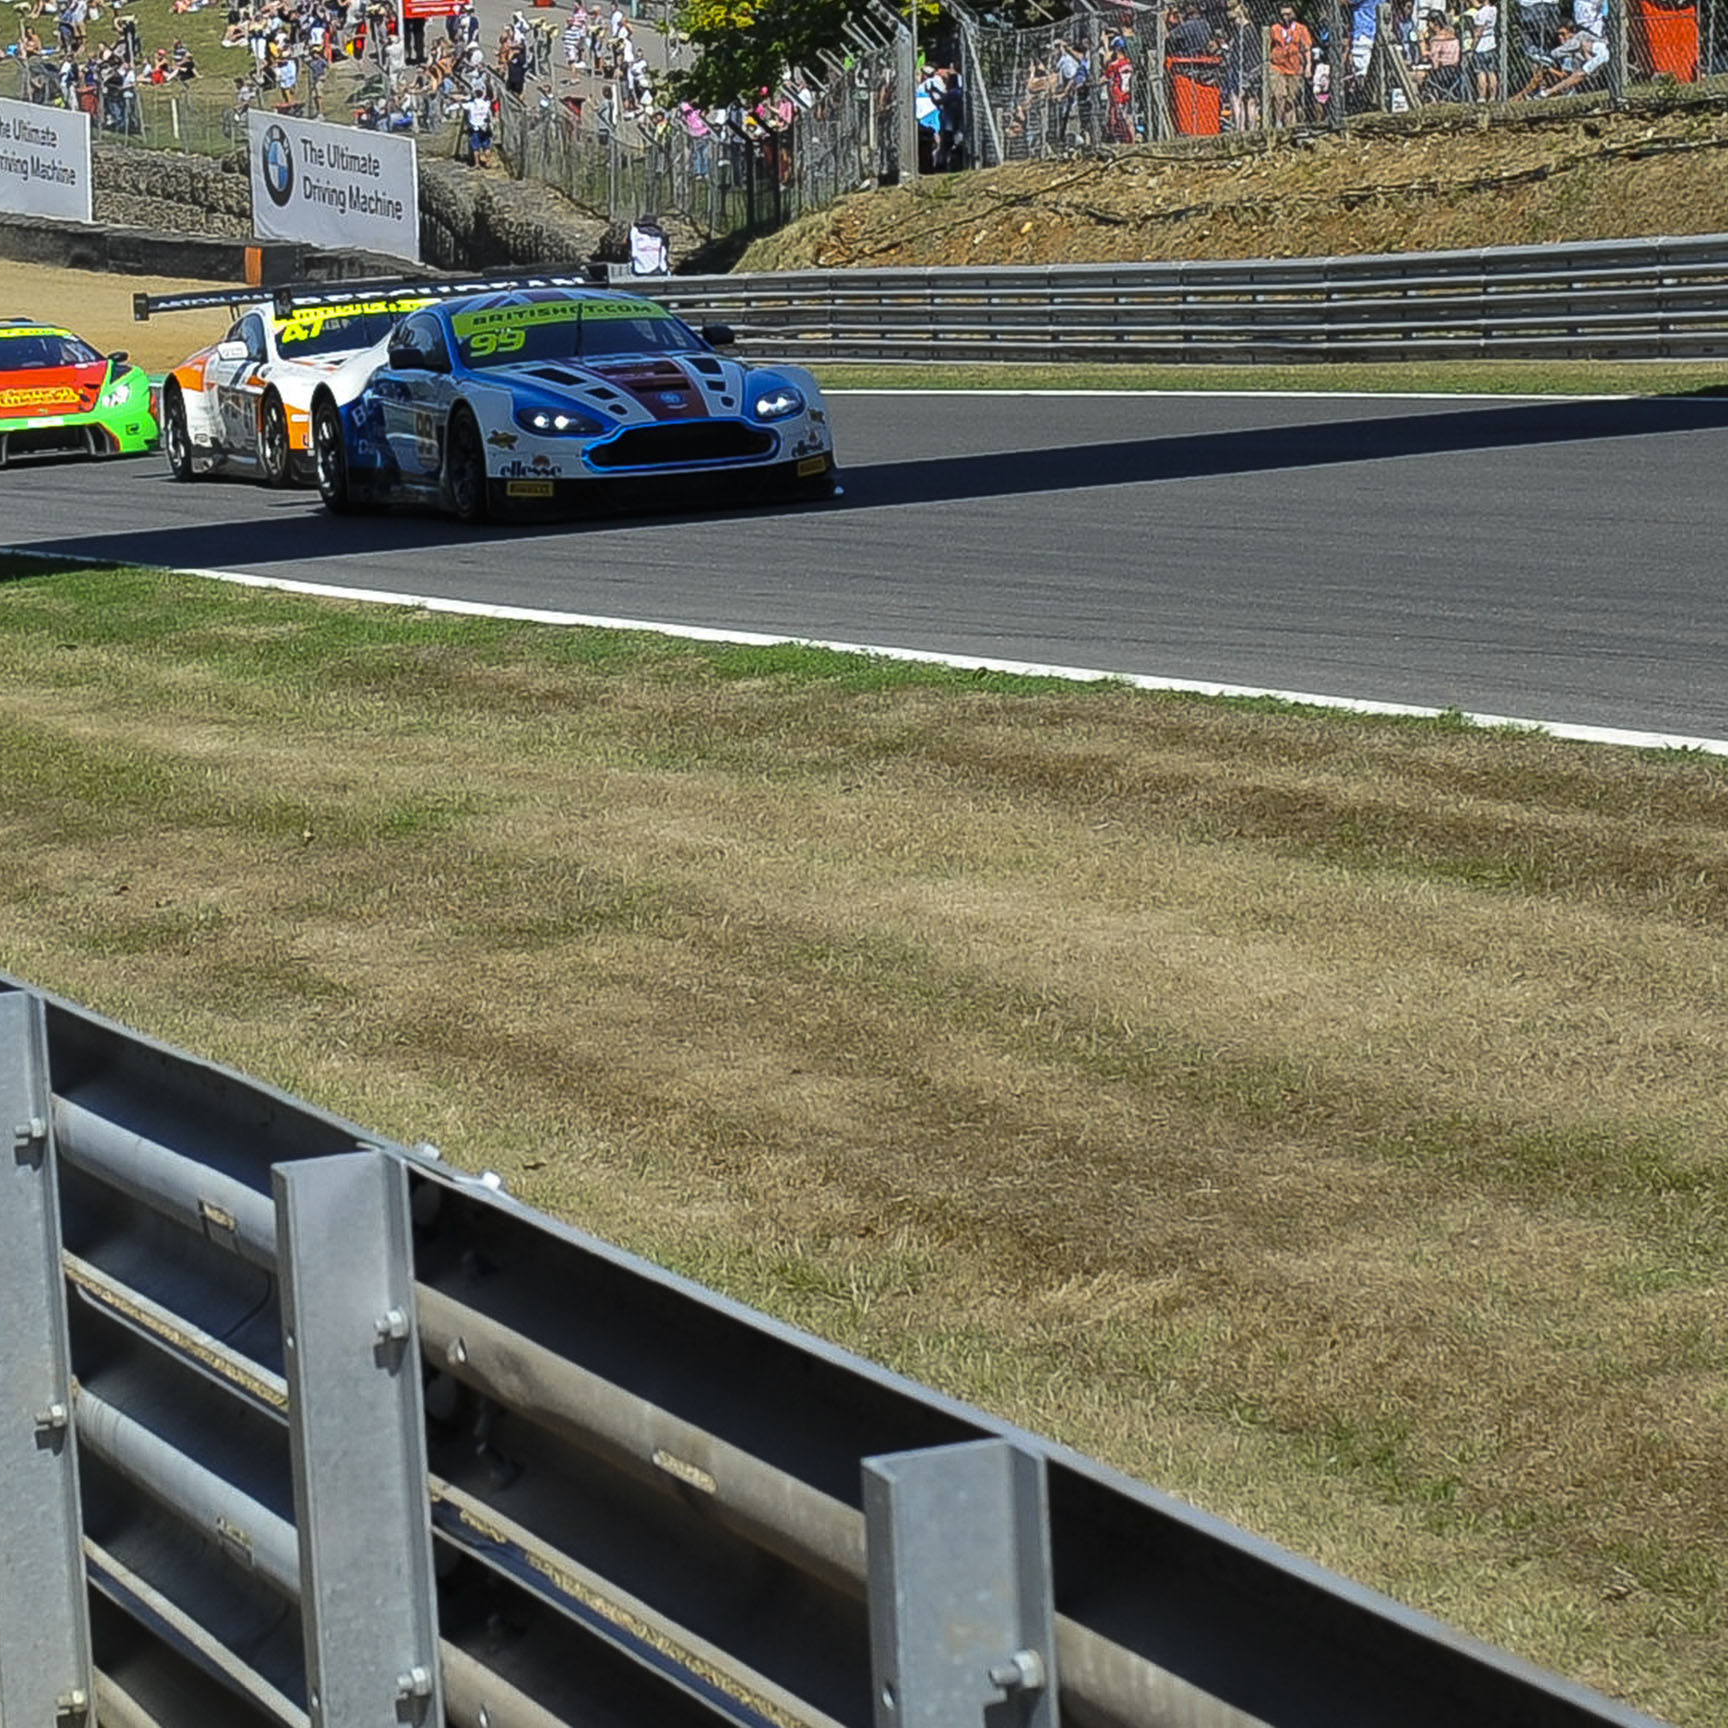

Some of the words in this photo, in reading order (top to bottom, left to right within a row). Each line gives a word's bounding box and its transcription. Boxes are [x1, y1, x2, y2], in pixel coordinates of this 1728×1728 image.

[13, 118, 58, 148] Ultimate
[30, 155, 76, 186] Machine
[300, 138, 325, 166] The
[327, 144, 380, 177] Ultimate
[303, 176, 346, 214] Driving
[348, 184, 403, 220] Machine
[470, 327, 526, 357] 99
[499, 460, 563, 478] ellesse
